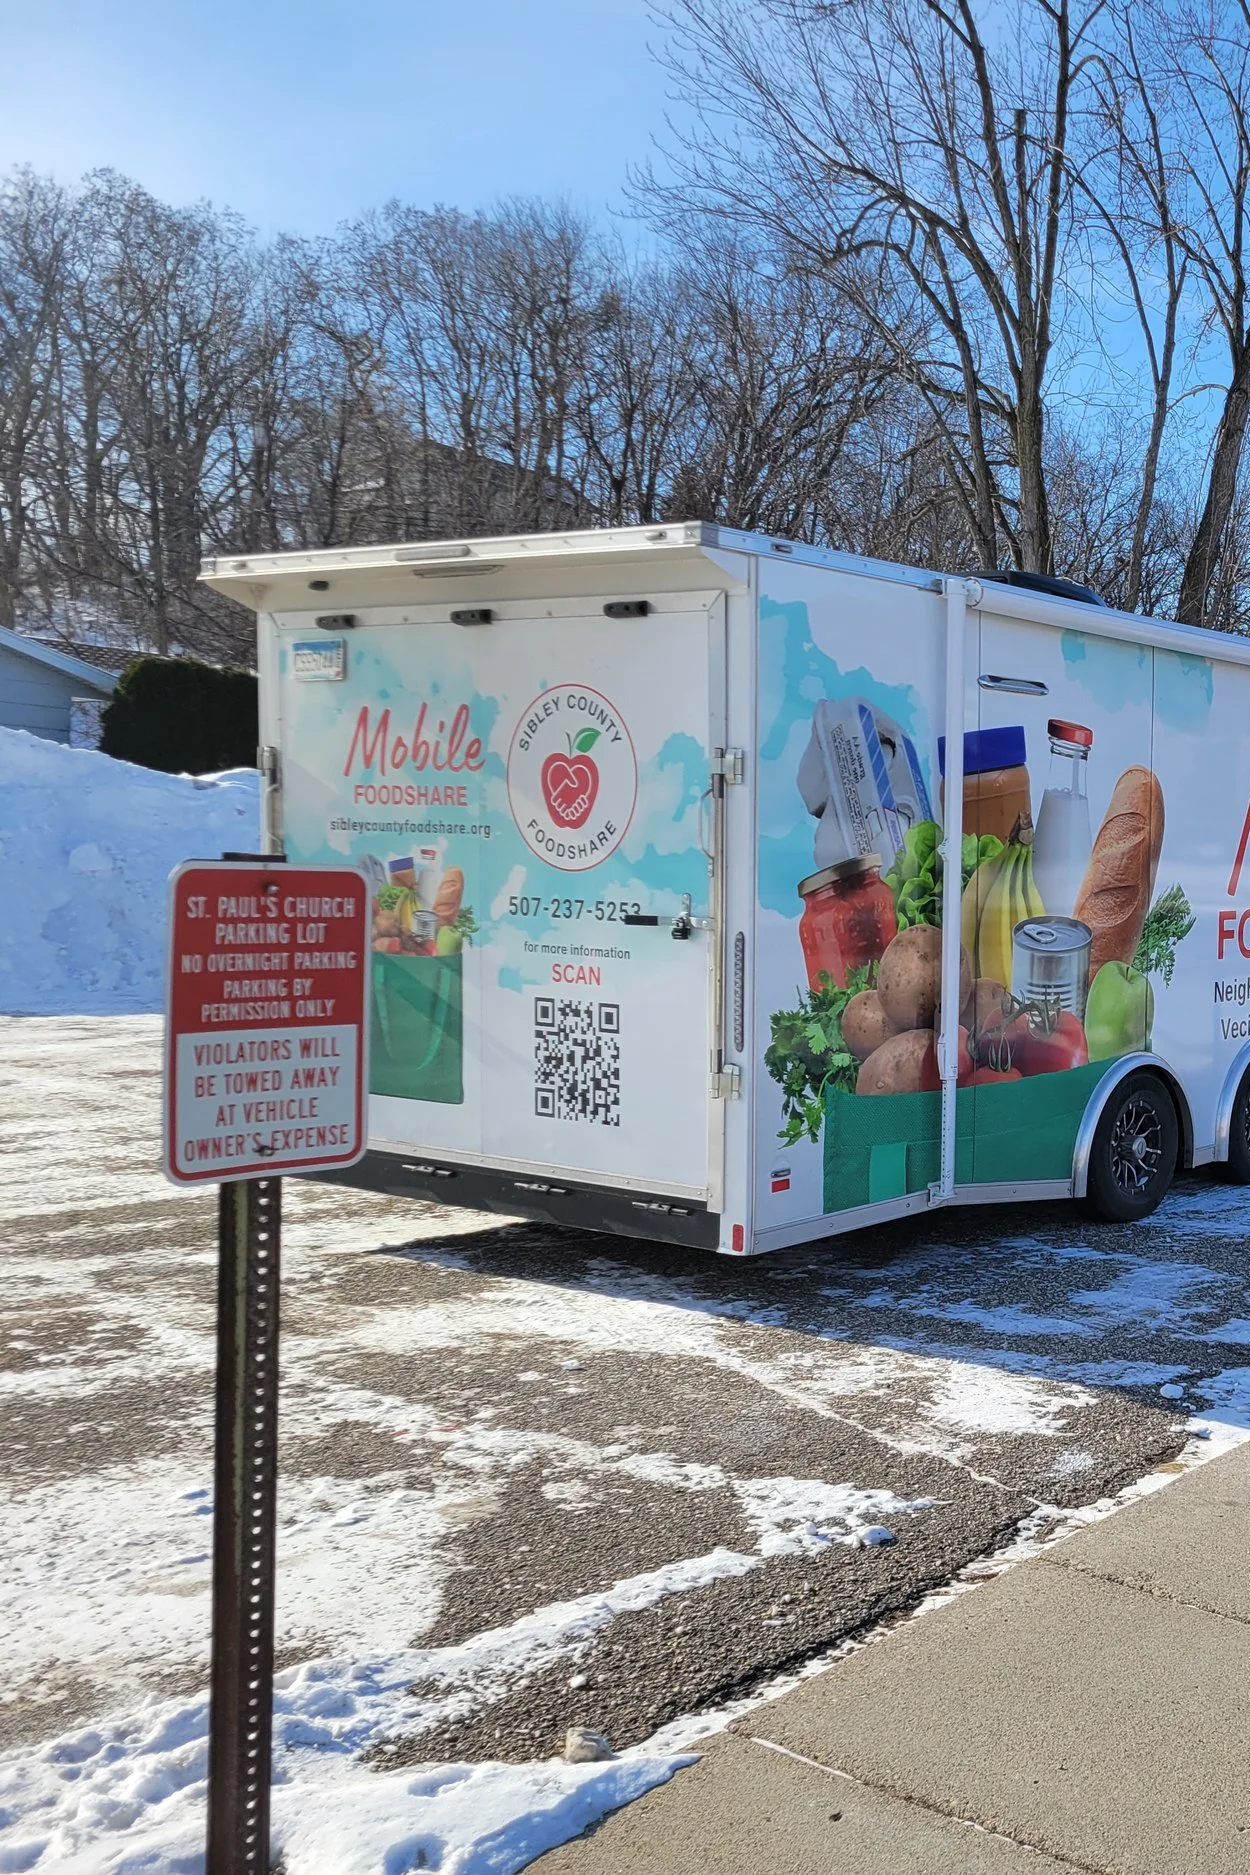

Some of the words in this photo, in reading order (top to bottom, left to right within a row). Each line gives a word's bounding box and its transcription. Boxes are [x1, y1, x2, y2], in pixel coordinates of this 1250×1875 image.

[519, 696, 561, 751] SIBLEY
[566, 694, 622, 744] COUNTY
[343, 702, 485, 777] Mobile
[354, 784, 468, 806] FOODSHARE
[330, 818, 491, 838] sibleycountyfoodshare.org
[527, 819, 617, 859] FOODSHARE
[186, 896, 212, 919] ST.
[217, 897, 279, 919] PAUL'S
[283, 897, 355, 919] CHURCH
[509, 895, 641, 922] 507-237-5253
[215, 923, 290, 944] PARKING
[297, 923, 328, 944] LOT
[181, 954, 203, 973] NO
[207, 952, 290, 972] OVERNIGHT
[294, 951, 357, 970] PARKING
[524, 940, 539, 954] for
[541, 944, 568, 955] more
[570, 943, 631, 960] information
[551, 963, 601, 986] SCAN
[223, 979, 287, 999] PARKING
[293, 978, 314, 997] BY
[201, 1000, 291, 1023] PERMISSION
[295, 999, 336, 1018] ONLY
[193, 1040, 291, 1067] VIOLATORS
[298, 1036, 341, 1059] WILL
[194, 1075, 217, 1098] BE
[223, 1070, 282, 1095] TOWED
[289, 1065, 341, 1089] AWAY
[214, 1104, 236, 1128] AT
[243, 1097, 319, 1125] VEHICLE
[184, 1133, 262, 1161] OWNER'S
[270, 1124, 350, 1151] EXPENSE
